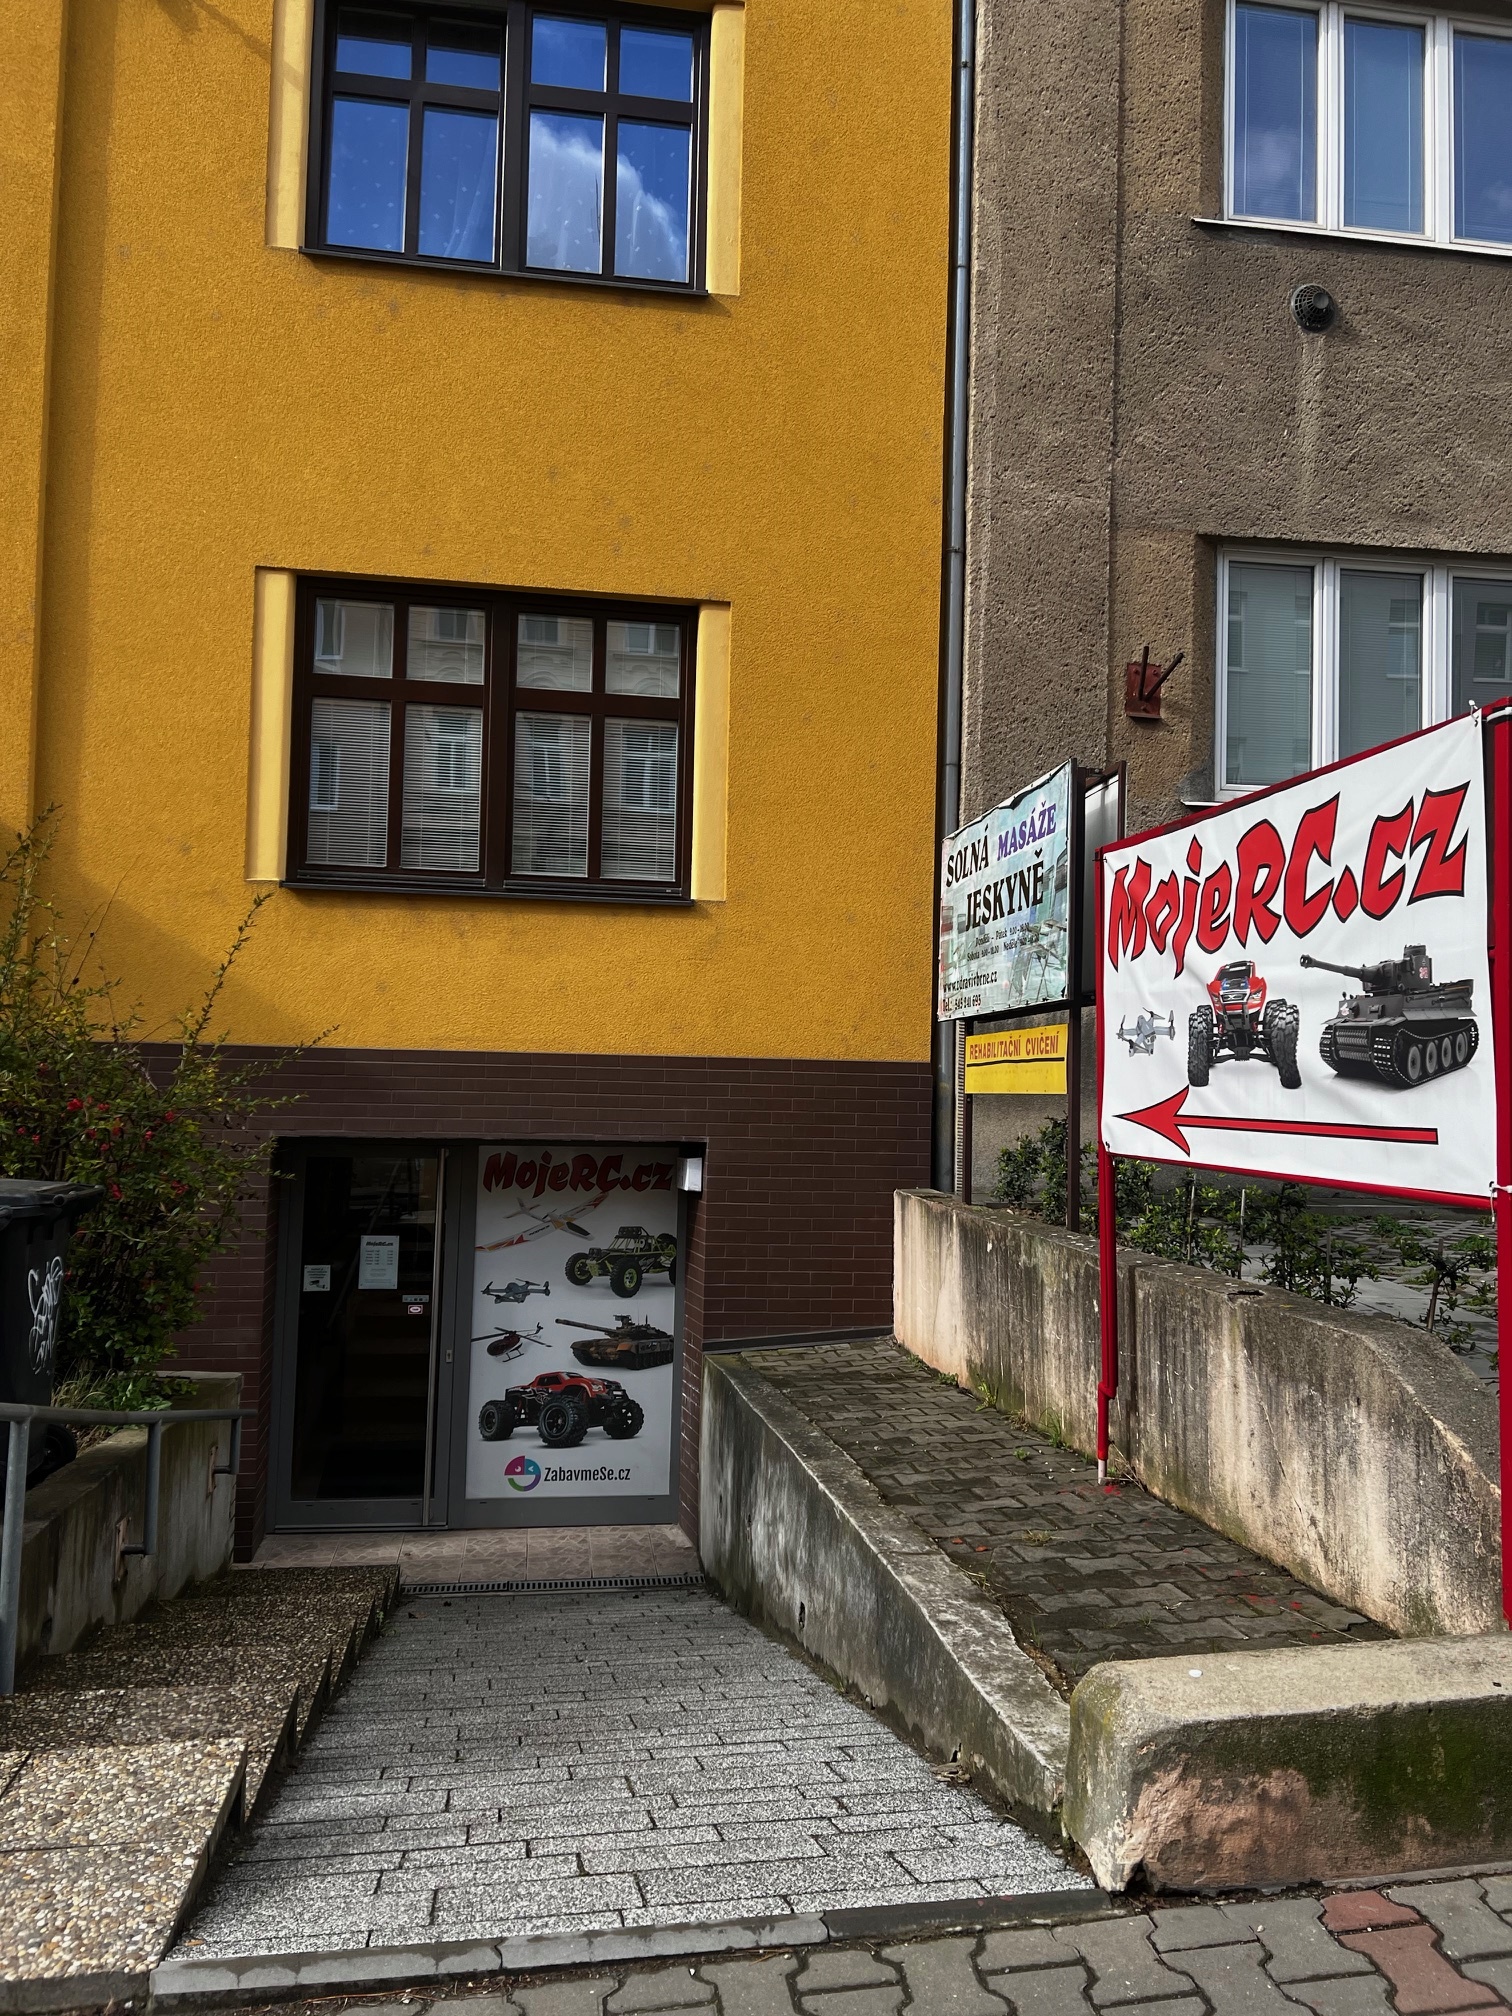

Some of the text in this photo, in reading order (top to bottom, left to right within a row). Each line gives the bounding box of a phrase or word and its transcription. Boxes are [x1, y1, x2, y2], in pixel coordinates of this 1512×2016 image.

[946, 801, 1057, 887] SOLNÁ MASÁŽE
[966, 847, 1044, 932] JESKYNĚ
[1107, 780, 1471, 979] MojeRC.cz
[970, 1031, 1060, 1060] REHABILITAČNÍ CVIČENÍ
[483, 1150, 675, 1199] MojeRC.cz
[544, 1466, 631, 1482] ZabavmeSe.cz
